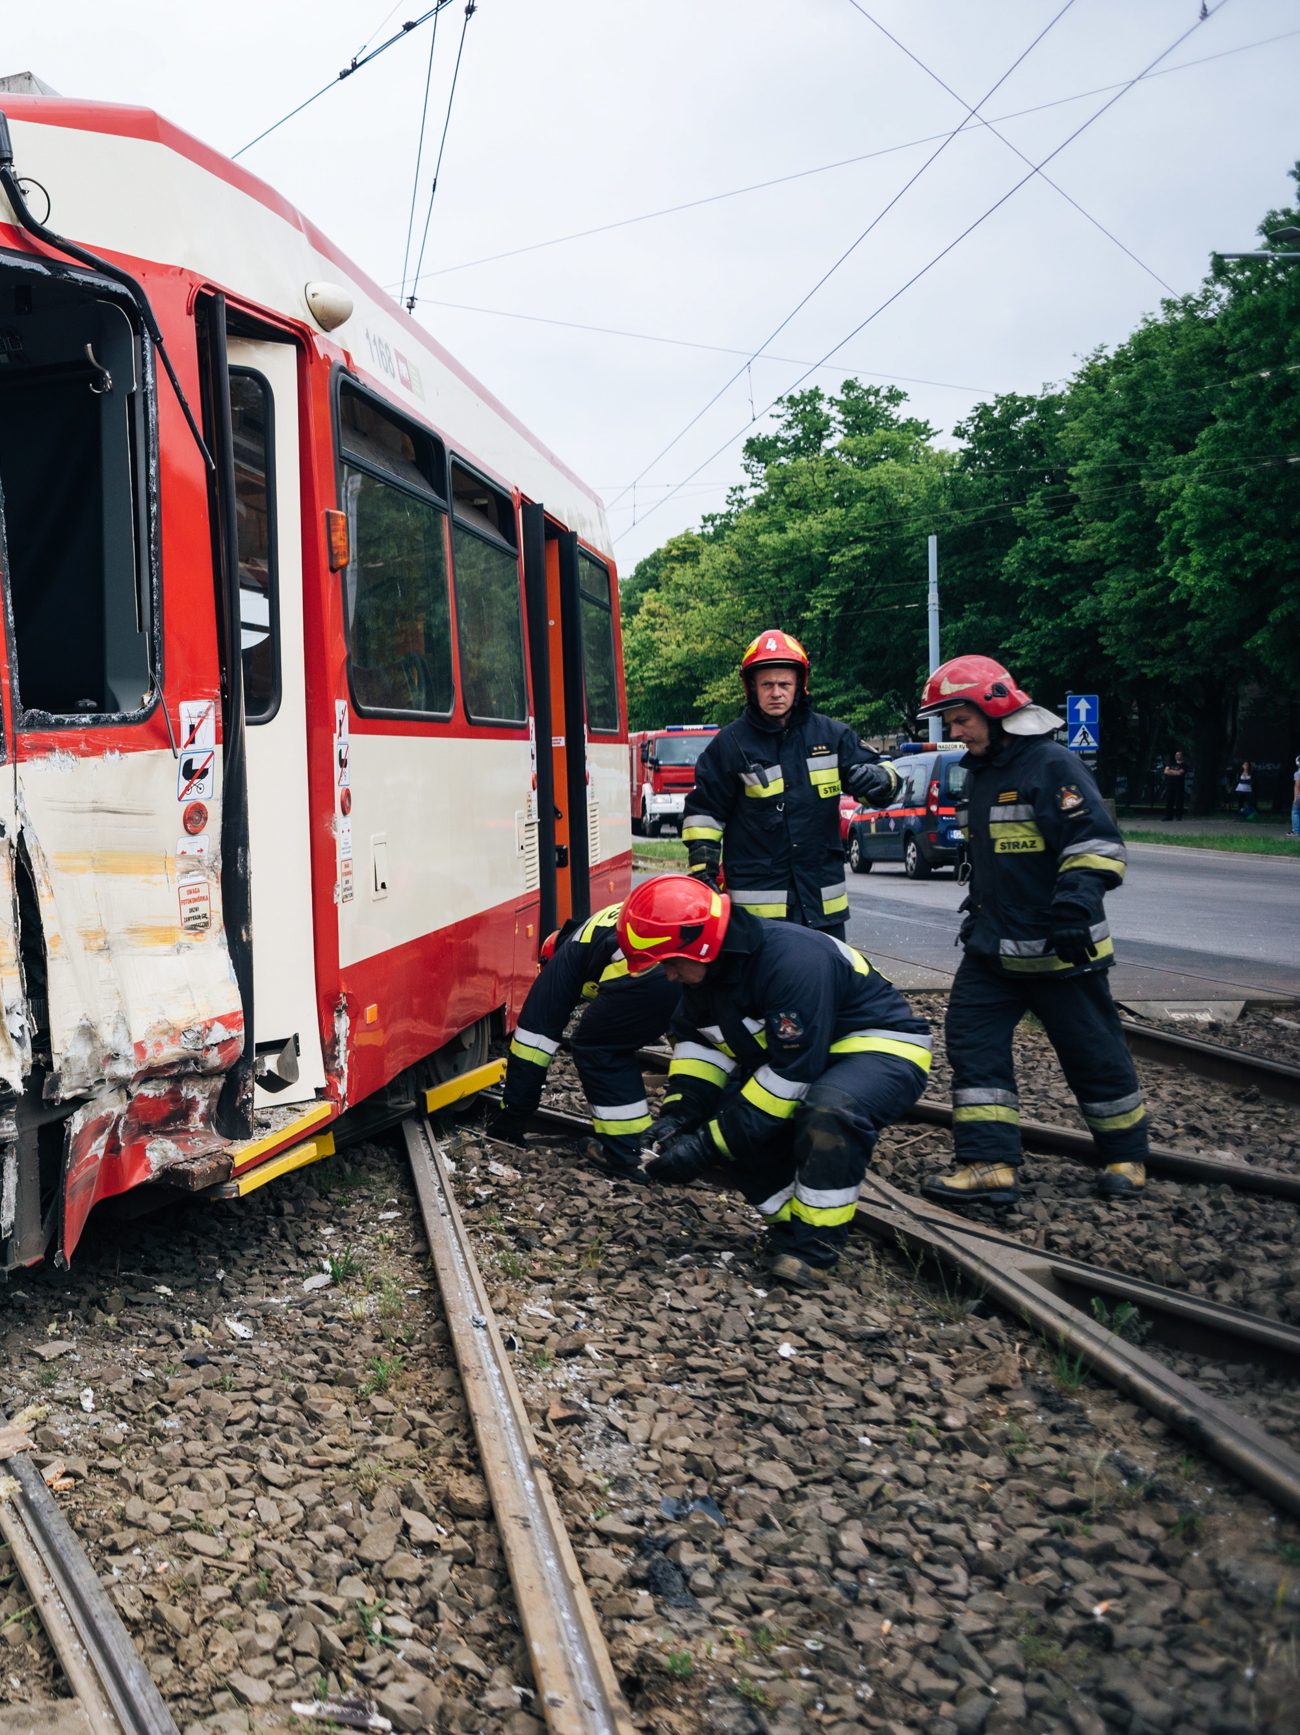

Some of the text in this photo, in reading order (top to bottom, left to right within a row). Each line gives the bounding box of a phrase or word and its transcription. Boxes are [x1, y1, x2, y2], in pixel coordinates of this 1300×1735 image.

[365, 327, 396, 379] 1168
[766, 637, 778, 652] 4
[186, 887, 201, 896] UWAGA
